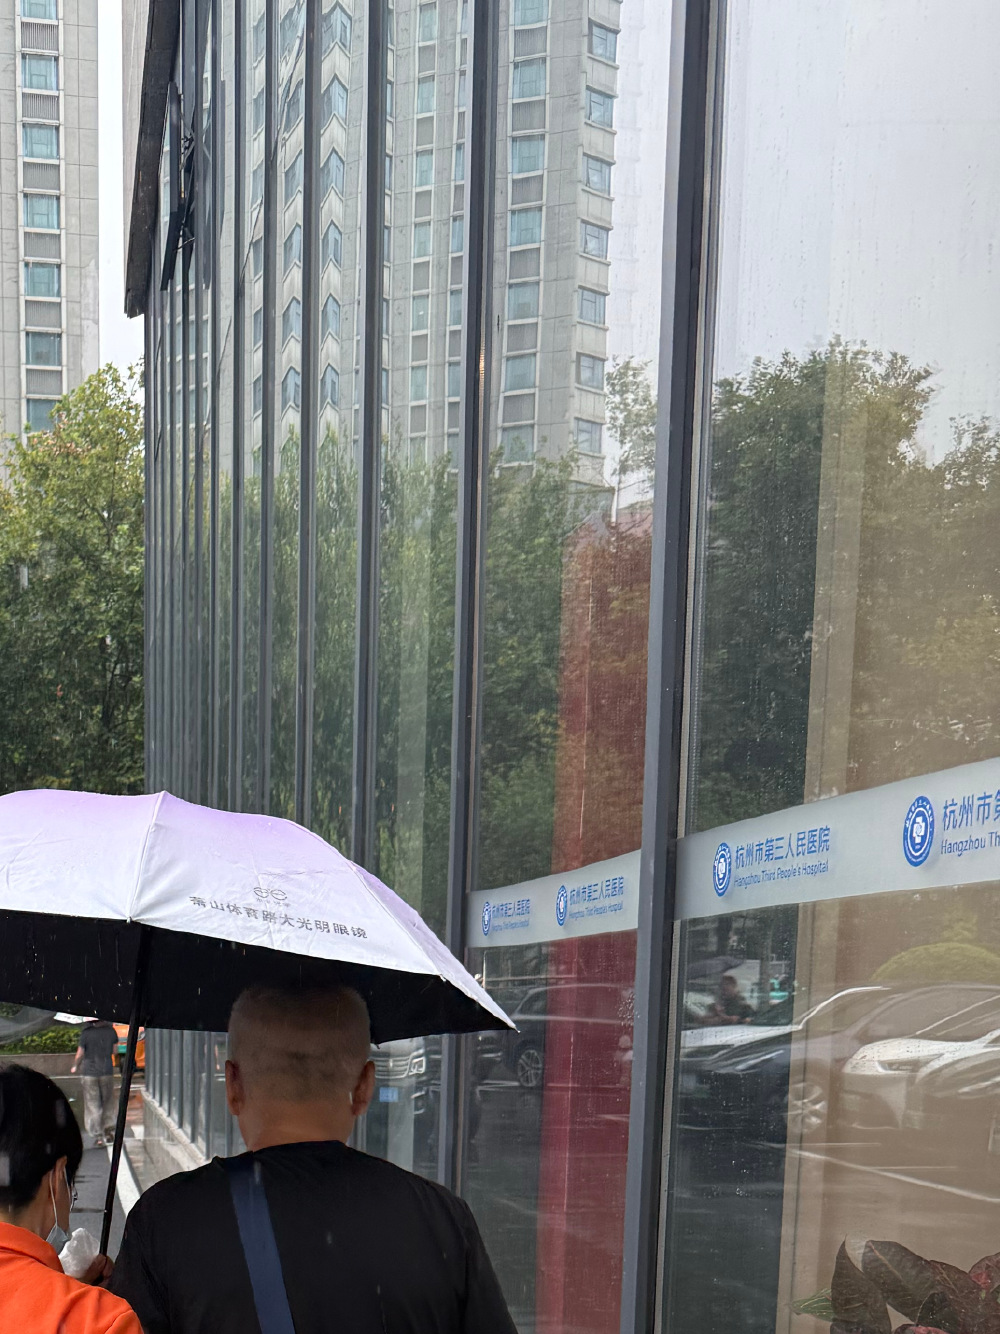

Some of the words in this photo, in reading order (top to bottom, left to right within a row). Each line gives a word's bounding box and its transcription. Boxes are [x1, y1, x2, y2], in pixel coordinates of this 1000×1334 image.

[735, 825, 831, 870] 杭州市第三人民医院
[940, 835, 986, 857] Hangzhou
[802, 859, 829, 877] Hospital
